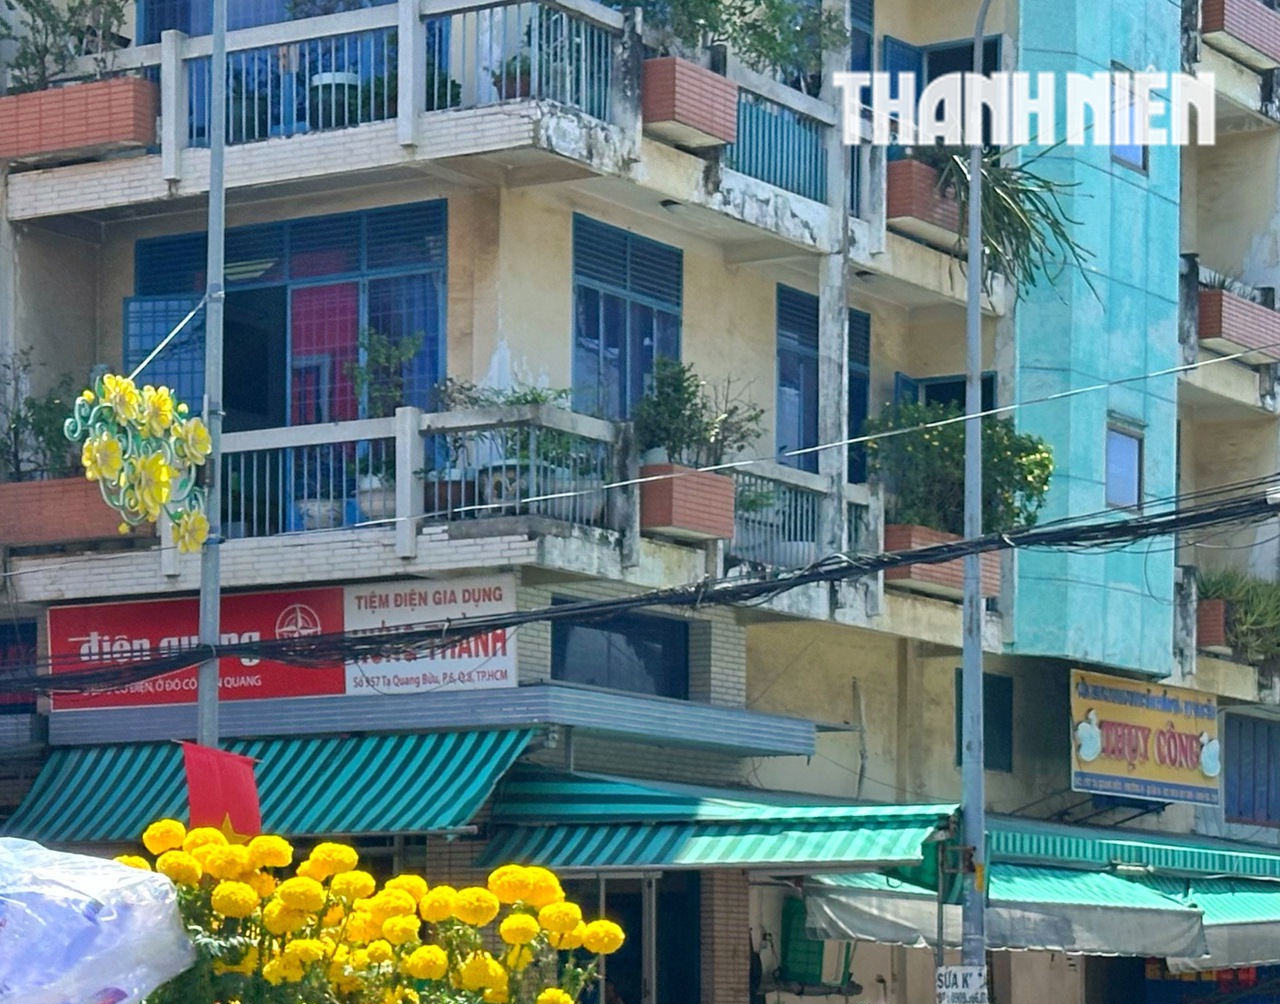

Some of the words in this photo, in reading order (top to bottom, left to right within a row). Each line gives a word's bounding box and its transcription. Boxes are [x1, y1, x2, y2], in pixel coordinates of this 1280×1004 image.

[355, 591, 390, 614] TIỆM
[394, 588, 428, 612] ĐIỆN
[432, 589, 458, 606] GIA
[462, 586, 503, 608] DỤNG
[224, 675, 262, 689] QUANG
[392, 674, 420, 688] Quang
